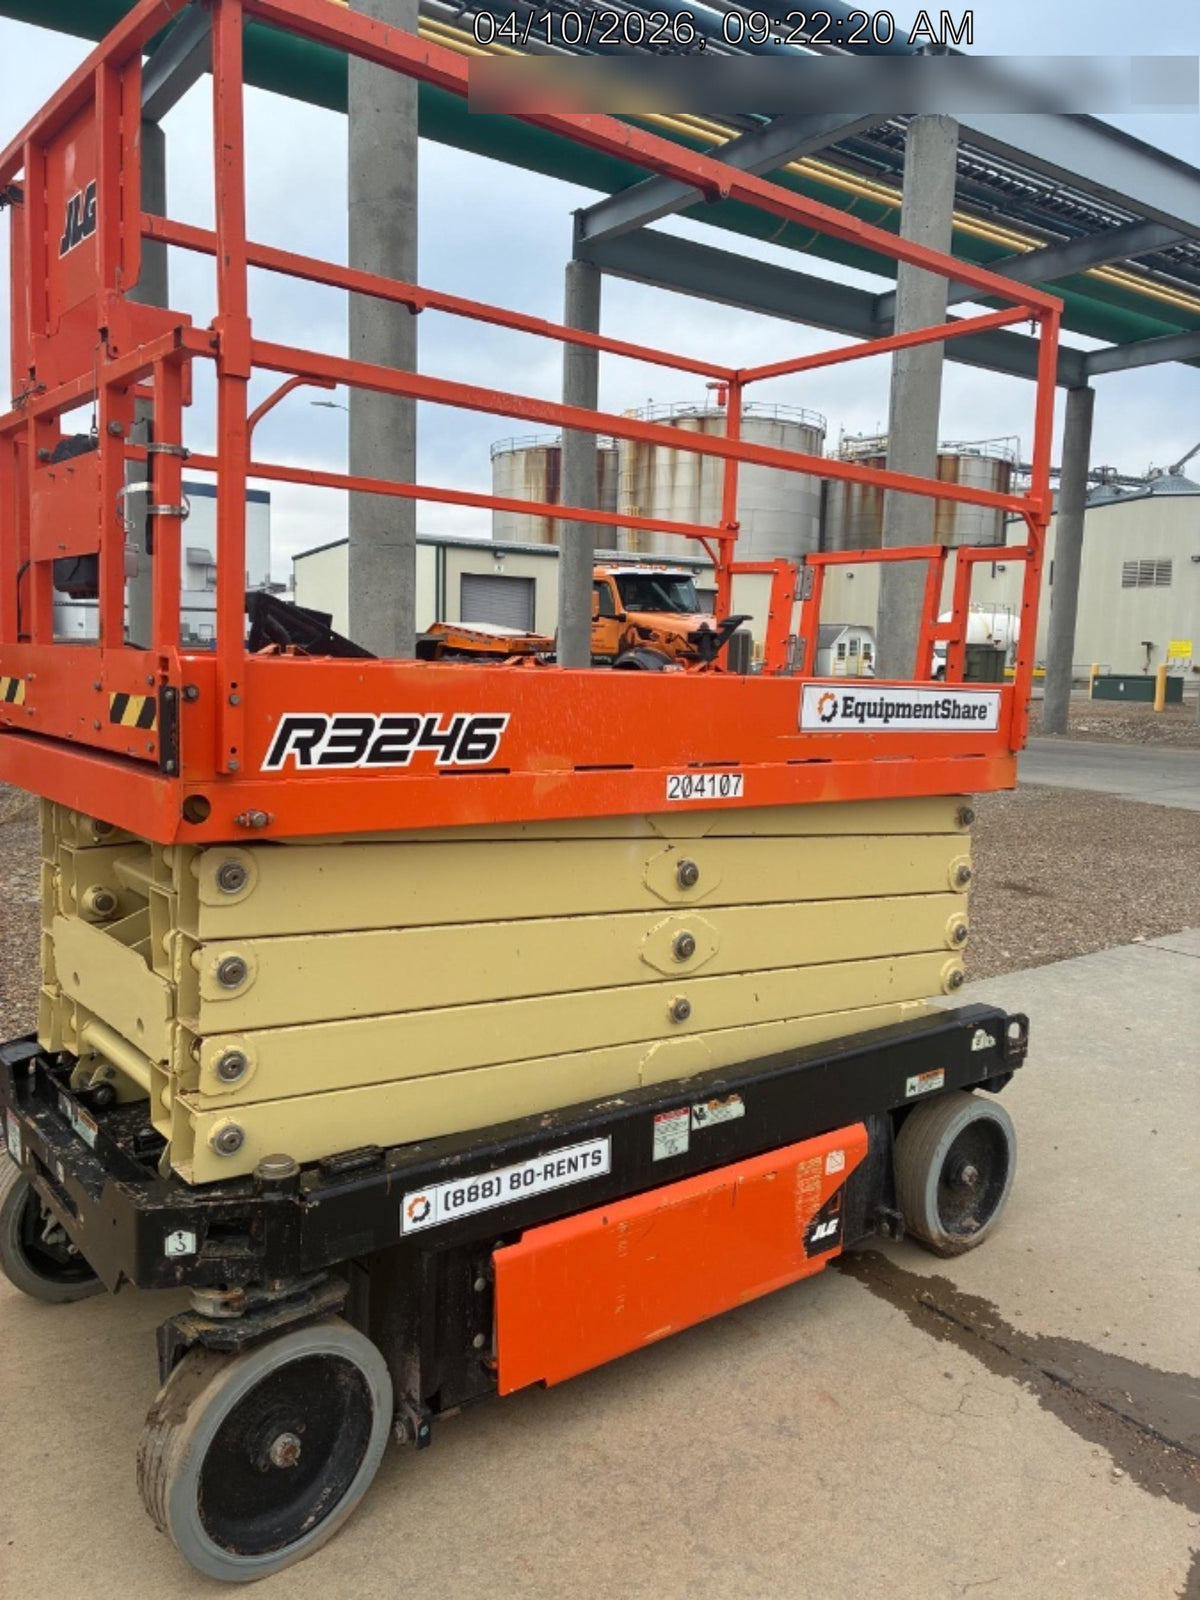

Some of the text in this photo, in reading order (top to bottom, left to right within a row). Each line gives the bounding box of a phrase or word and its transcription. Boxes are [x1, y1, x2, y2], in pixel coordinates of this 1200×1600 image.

[59, 178, 97, 258] JLG
[841, 696, 988, 723] EquipmentShare
[264, 715, 508, 769] R3246
[668, 774, 742, 798] 204107
[444, 1149, 602, 1211] (888) 80-RENTS
[810, 1217, 840, 1242] JLG
